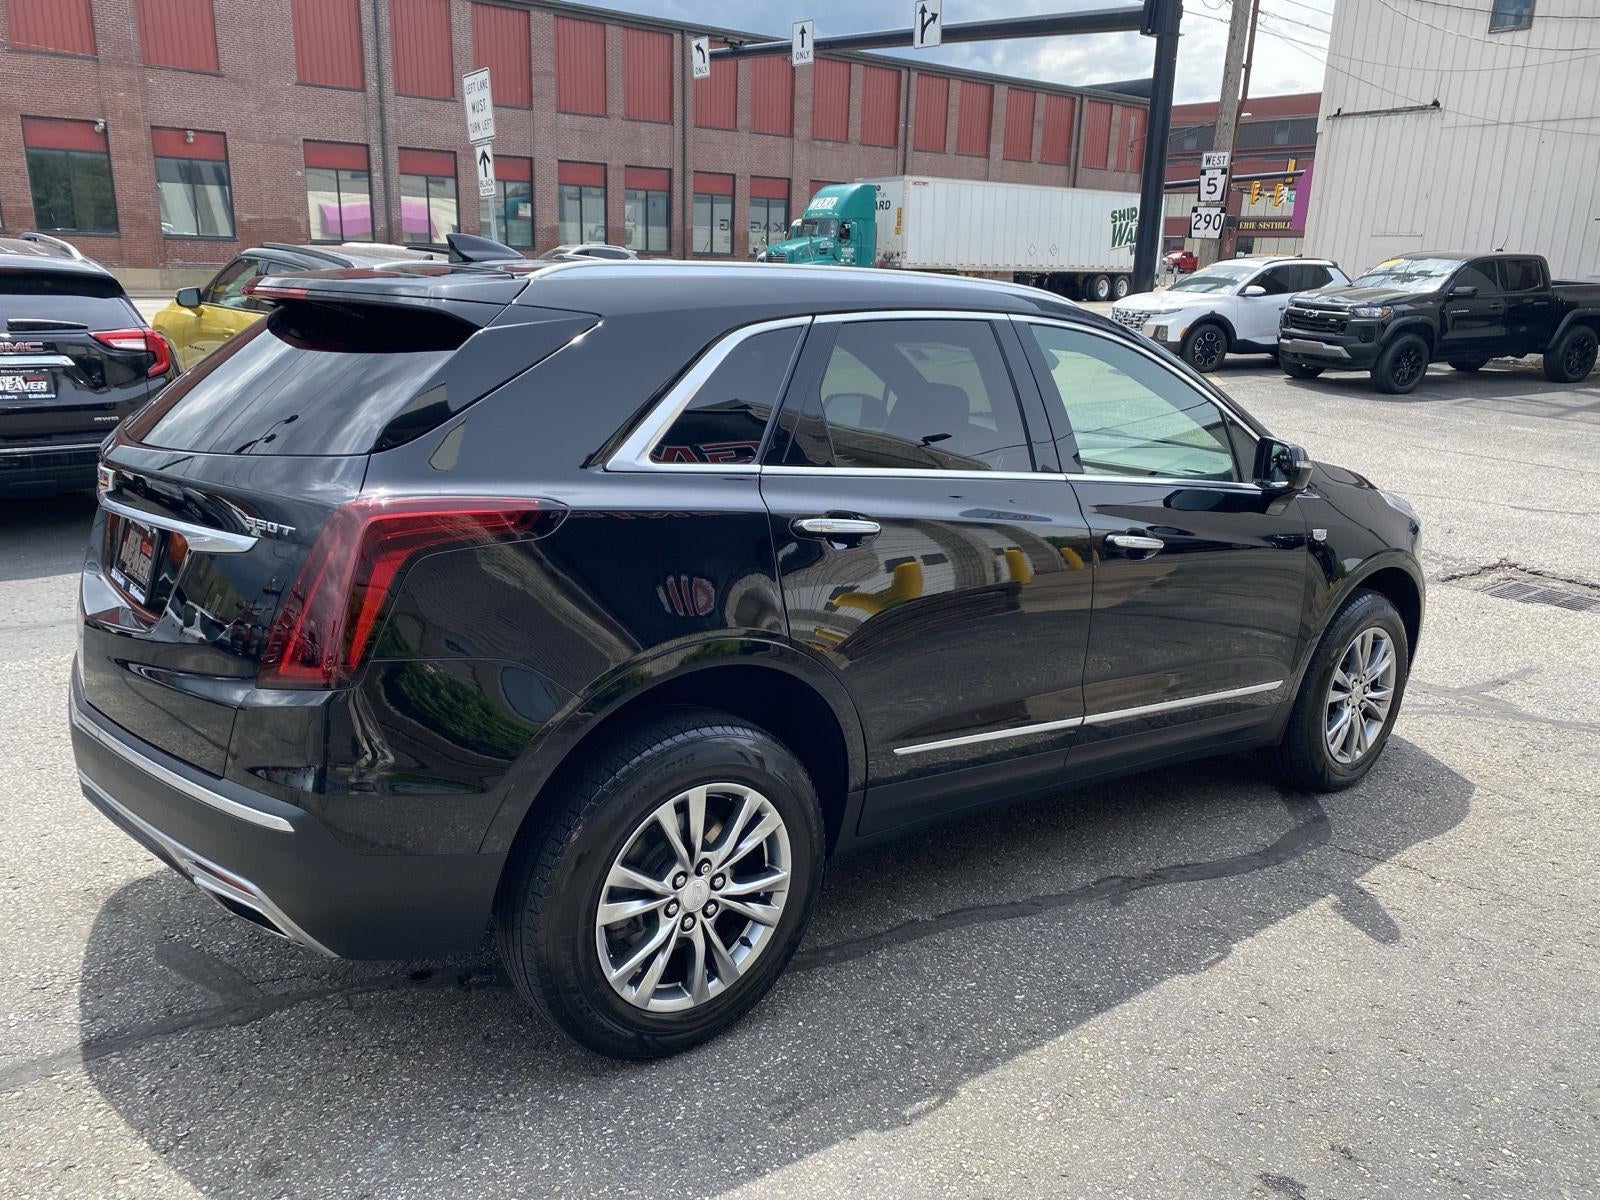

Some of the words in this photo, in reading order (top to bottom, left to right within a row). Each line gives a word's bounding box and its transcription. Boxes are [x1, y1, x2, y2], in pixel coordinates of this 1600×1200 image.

[795, 50, 810, 61] ONLY
[695, 65, 707, 75] ONLY
[465, 81, 476, 96] LEFT
[476, 78, 489, 92] LANE
[471, 98, 486, 114] MUST
[470, 121, 481, 133] TURN
[482, 118, 492, 131] LEFT
[1205, 155, 1227, 166] WEST
[479, 179, 494, 188] BLACK
[1205, 177, 1218, 195] 5
[808, 196, 839, 211] WARD
[1111, 207, 1137, 223] SHIP
[1193, 213, 1222, 231] 290
